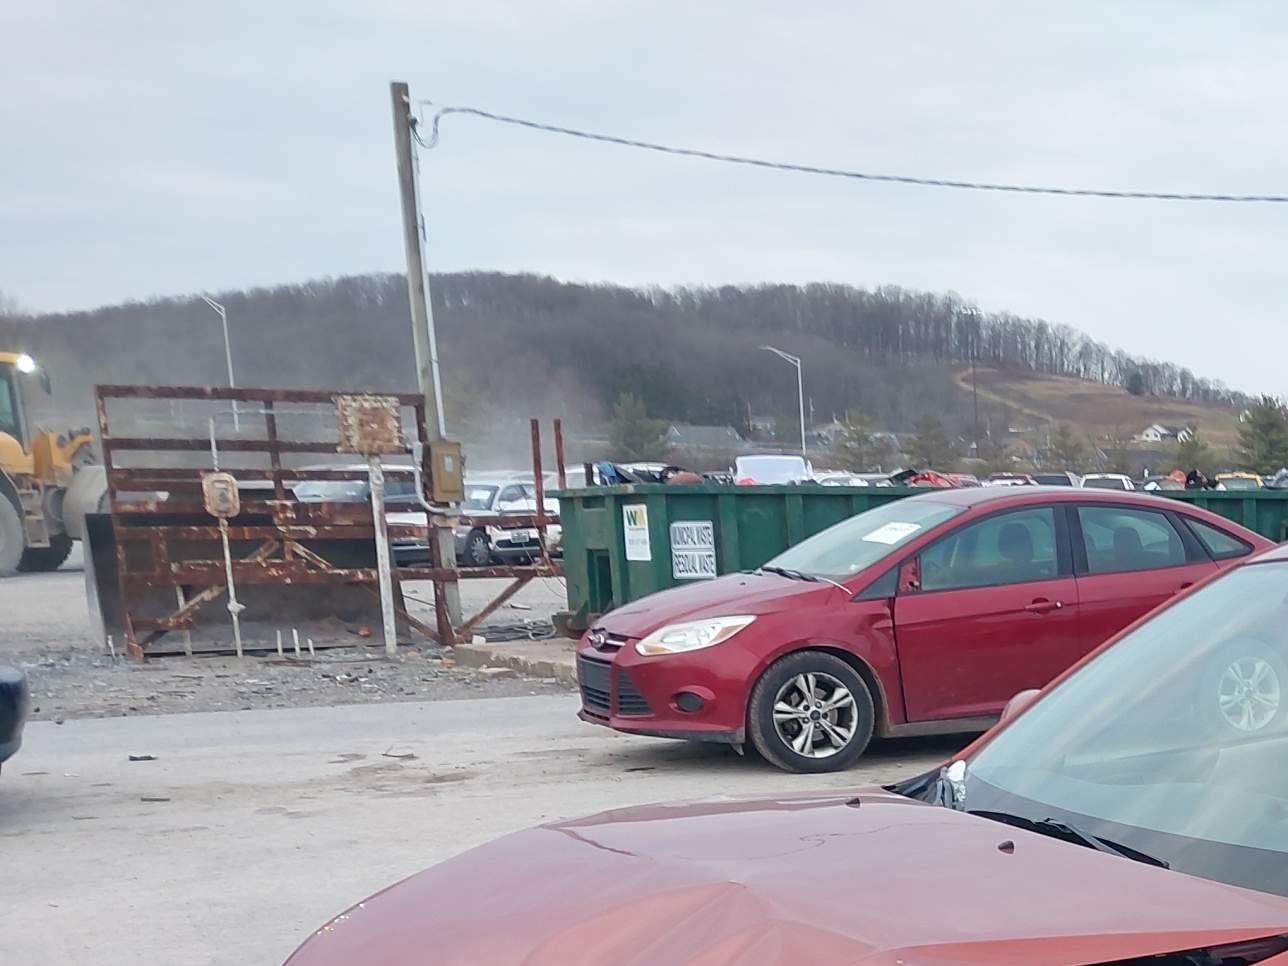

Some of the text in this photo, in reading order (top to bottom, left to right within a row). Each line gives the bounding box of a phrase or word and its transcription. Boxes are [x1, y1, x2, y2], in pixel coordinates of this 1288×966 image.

[672, 526, 712, 545] MUNICIPAL WASTE
[674, 554, 715, 574] RESIDUAL WASTE
